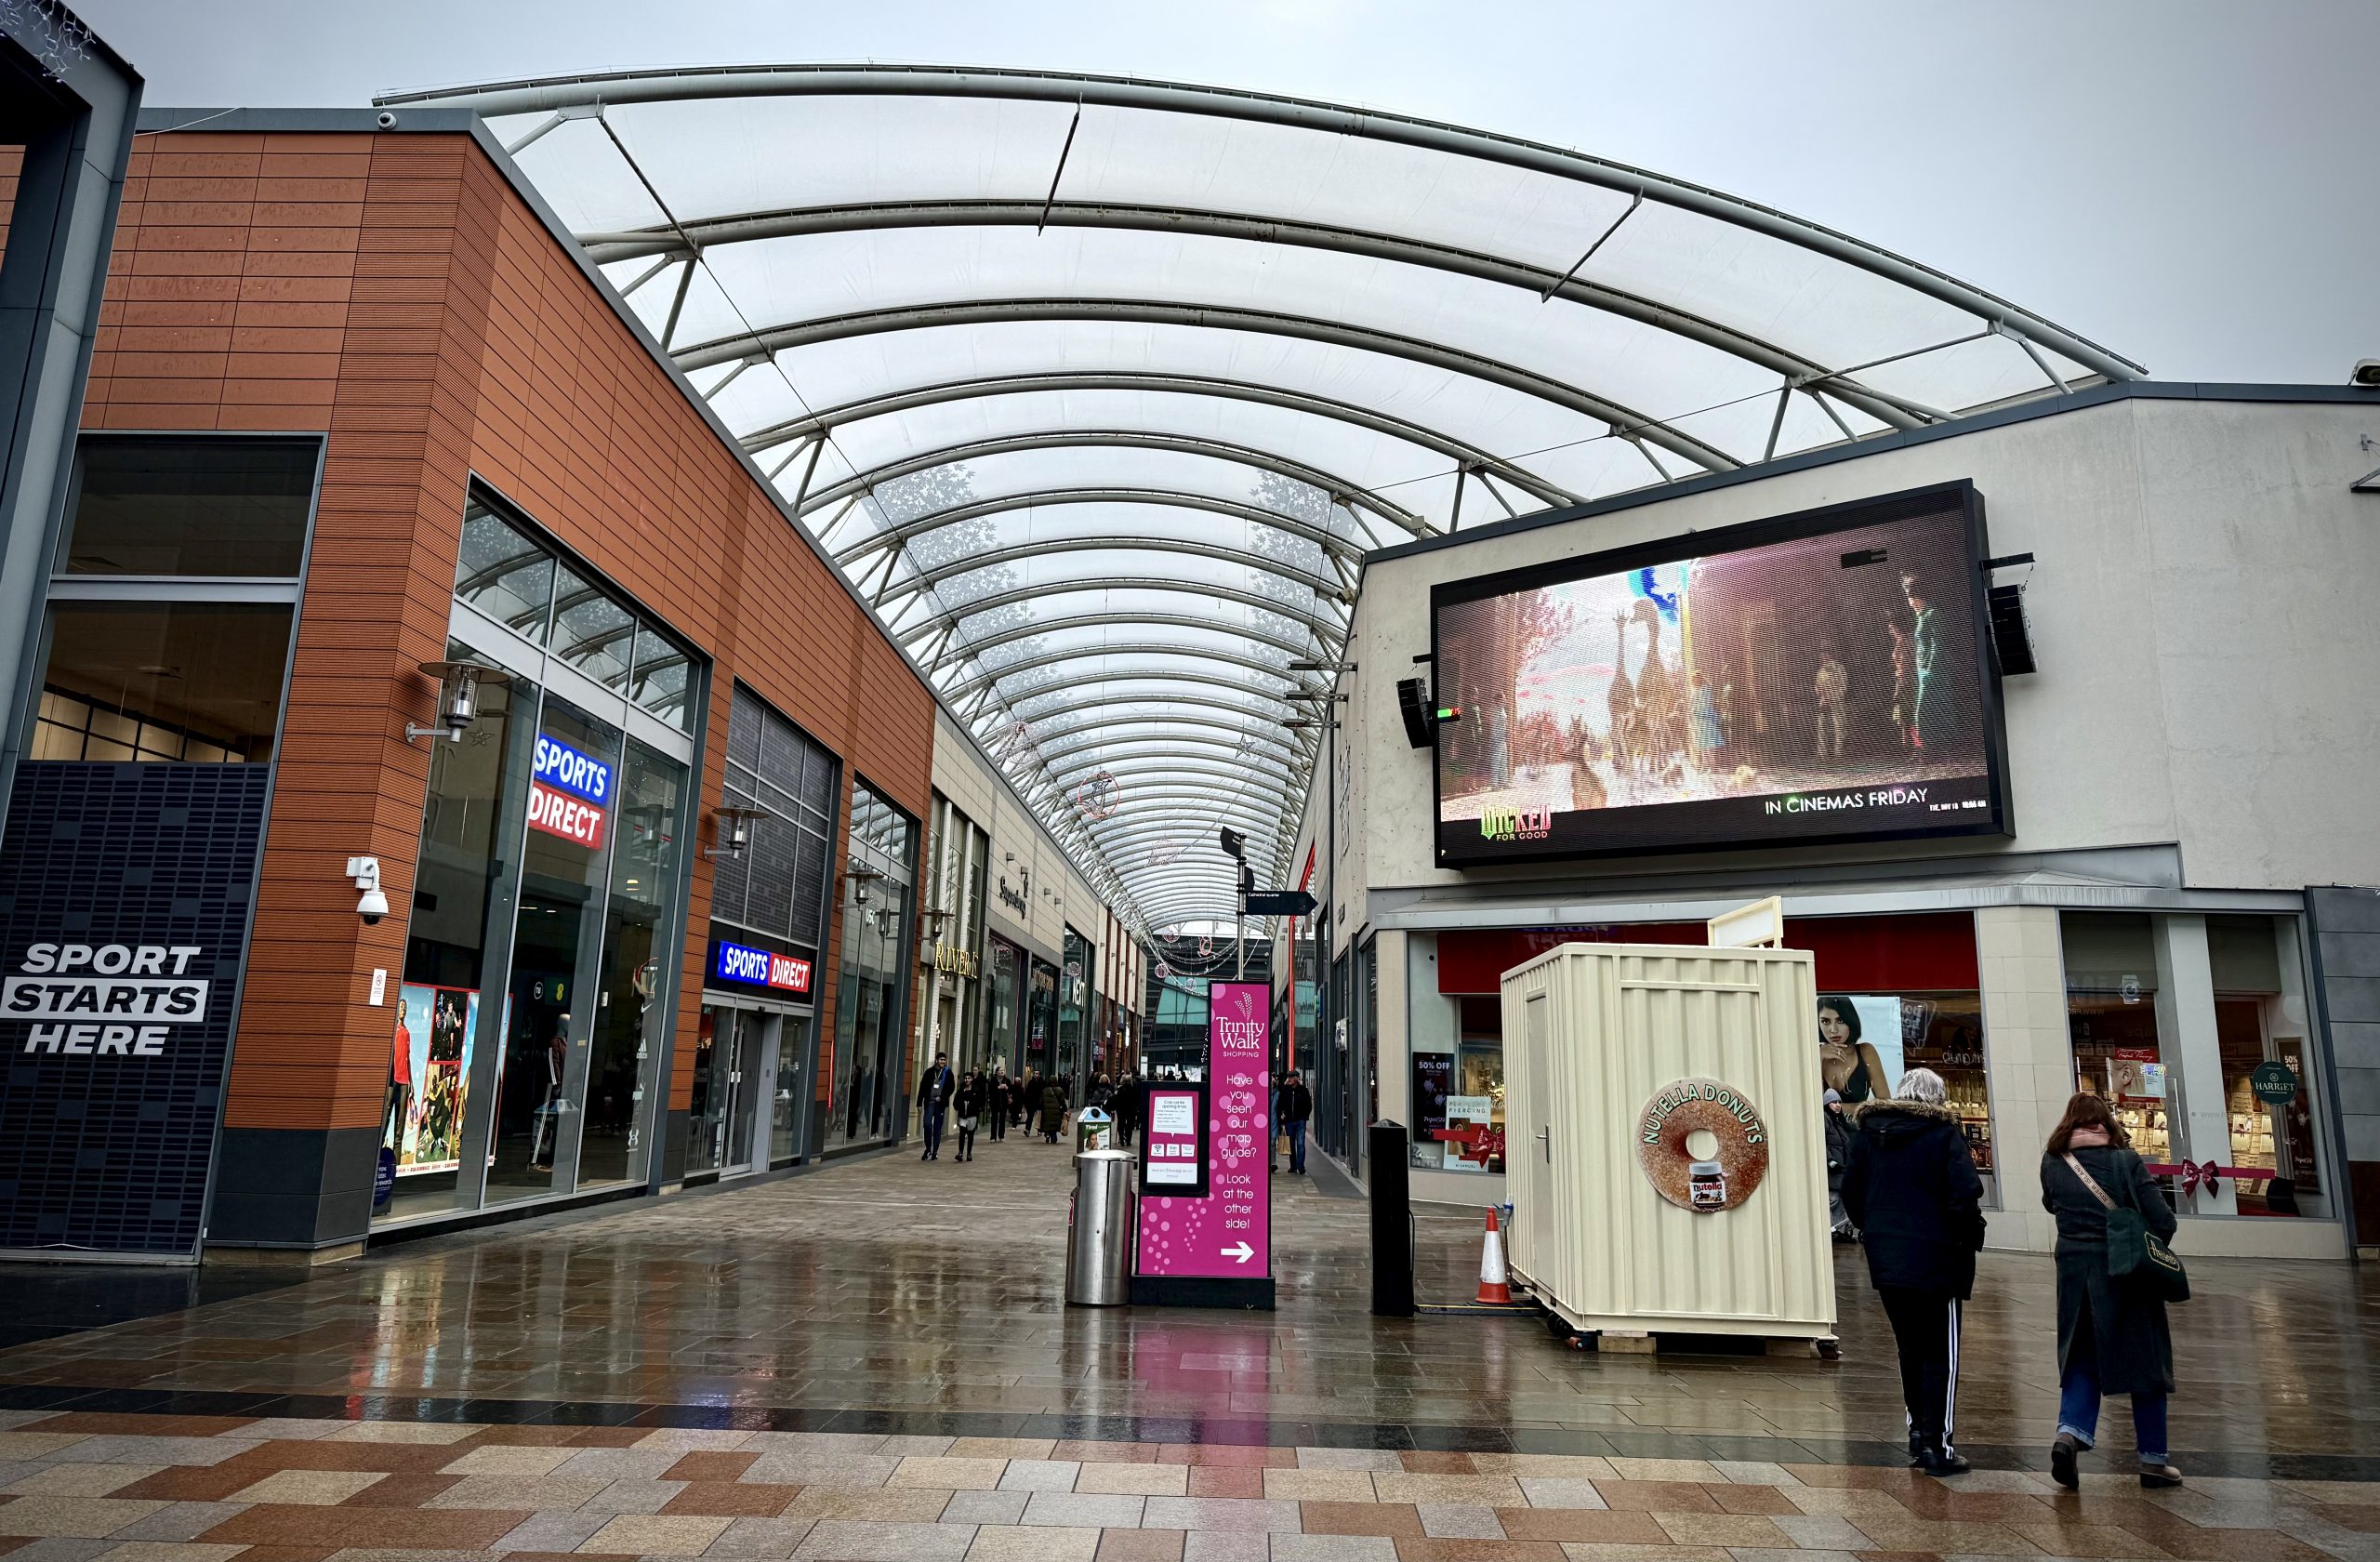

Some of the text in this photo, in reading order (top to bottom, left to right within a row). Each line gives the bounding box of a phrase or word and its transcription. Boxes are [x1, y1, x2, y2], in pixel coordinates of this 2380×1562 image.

[535, 738, 607, 798] SPORTS
[1765, 788, 1928, 814] IN CINEMAS FRIDAY
[528, 787, 601, 841] DIRECT
[1480, 804, 1553, 841] WICKED
[1496, 831, 1548, 841] FOR GOOD
[20, 943, 202, 975] SPORT
[724, 946, 808, 988] SPORTS DIRECT
[933, 942, 971, 976] RIVER
[7, 984, 200, 1015] STARTS
[1072, 976, 1086, 1008] NEXT
[1216, 1017, 1265, 1037] Trinity
[24, 1024, 170, 1056] HERE
[1220, 1032, 1261, 1050] Walk
[1419, 1061, 1450, 1070] 50% OFF
[1226, 1074, 1253, 1085] Have
[1230, 1091, 1250, 1101] you
[1226, 1105, 1252, 1114] seen
[1643, 1083, 1765, 1145] NUTELLA DONUTS
[1231, 1119, 1248, 1129] our
[1226, 1133, 1252, 1145] map
[1221, 1147, 1257, 1159] guide?
[1226, 1173, 1251, 1185] Look
[2073, 1163, 2092, 1184] ISLAND
[1223, 1188, 1254, 1199] at the
[1694, 1181, 1723, 1192] nutella
[1224, 1203, 1252, 1214] other
